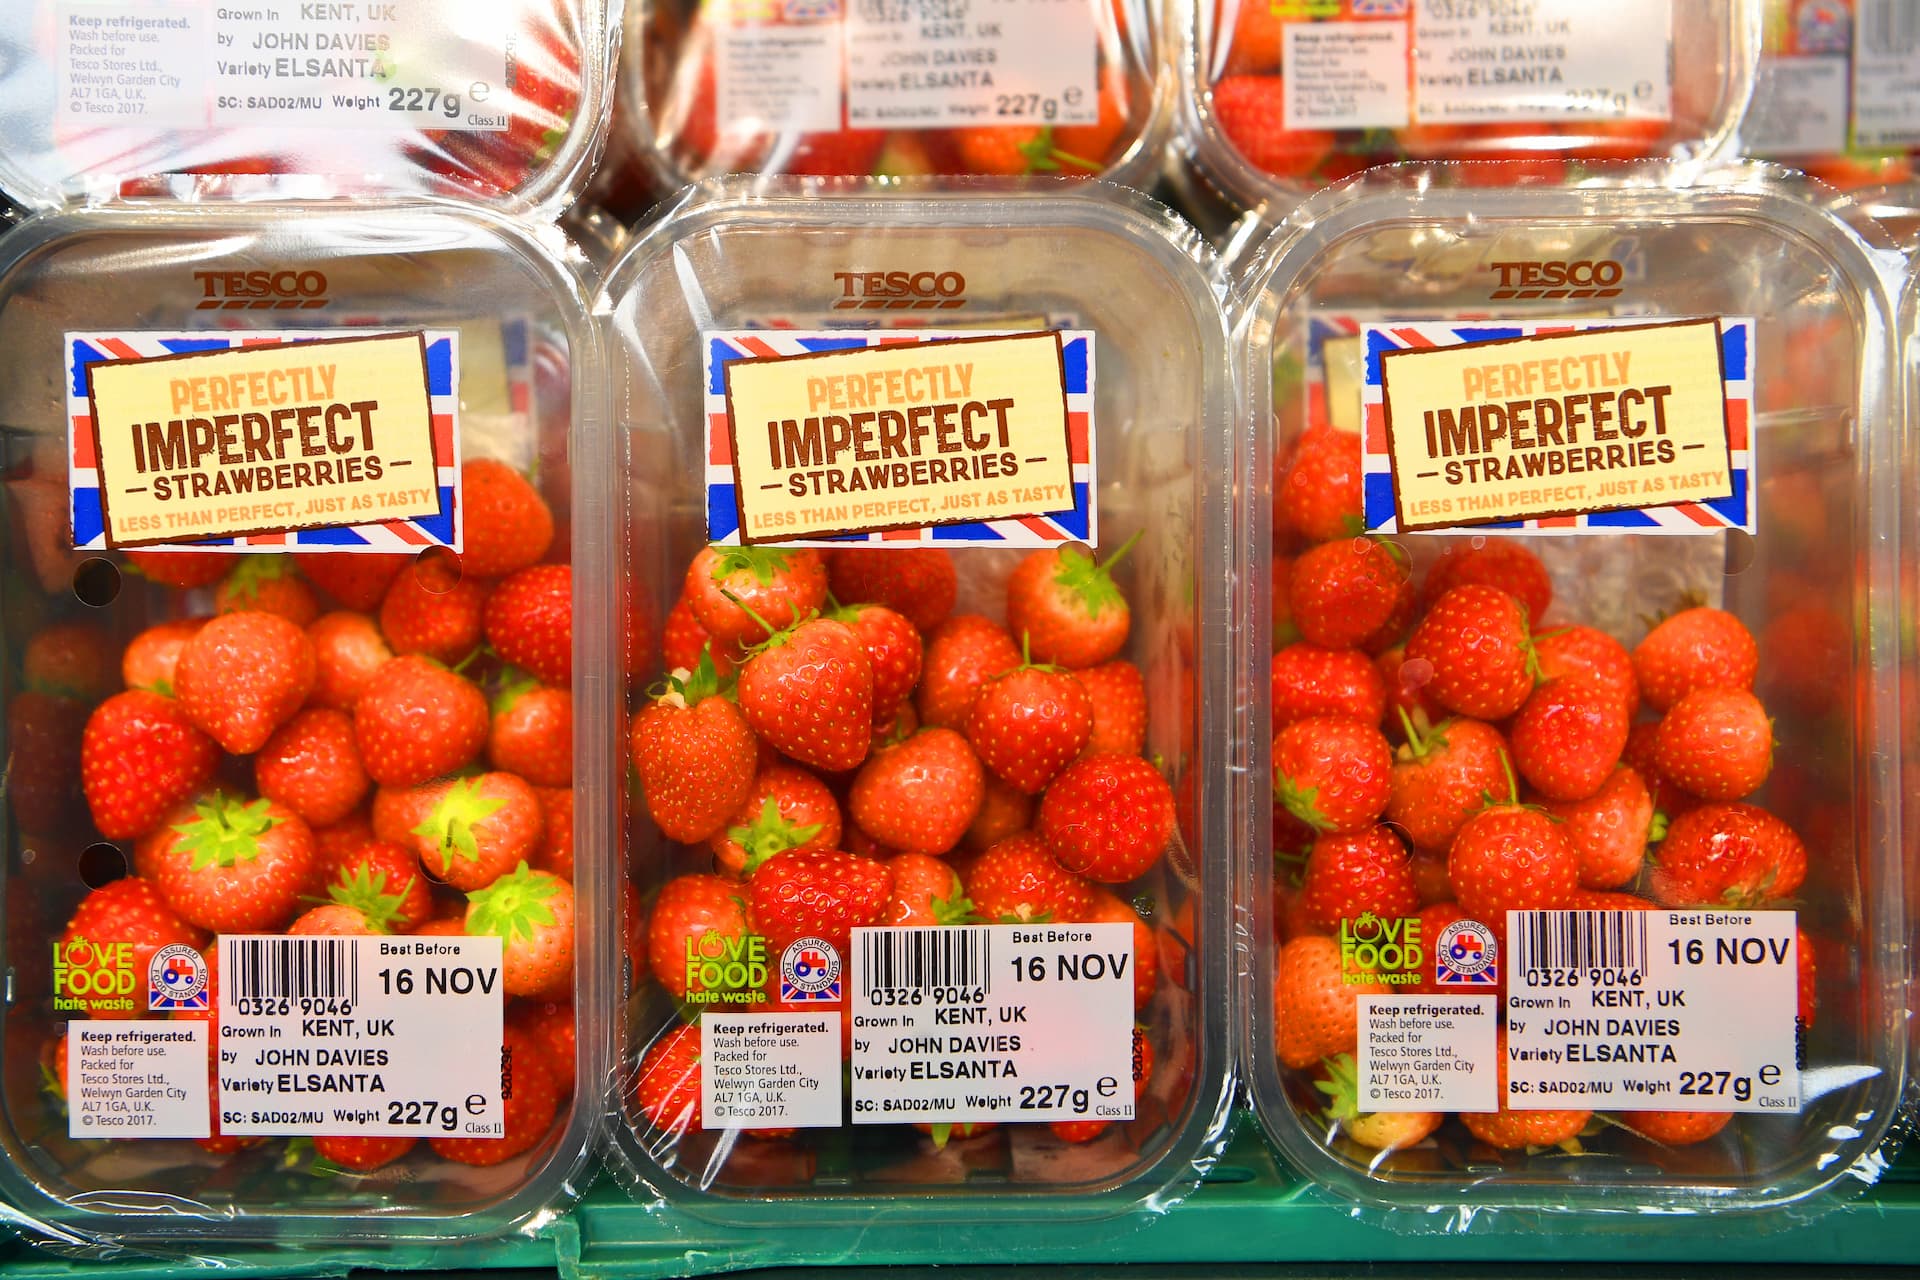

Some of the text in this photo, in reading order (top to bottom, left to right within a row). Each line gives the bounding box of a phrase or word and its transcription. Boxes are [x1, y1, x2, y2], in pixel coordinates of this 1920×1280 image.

[217, 3, 396, 22] Grown In KENT, UK
[217, 32, 390, 51] by JOHN DAVIES
[217, 58, 387, 78] Variety ELSANTA
[1467, 68, 1563, 85] ELSANTA
[899, 73, 995, 89] ELSANTA
[218, 87, 462, 118] SC: SAD02/MU Weight 227g
[996, 95, 1057, 120] 227g
[195, 270, 327, 297] TESCO
[1490, 260, 1622, 287] TESCO
[835, 271, 965, 297] TESCO
[1463, 351, 1630, 400] PERFECTLY
[170, 365, 336, 414] PERFECTLY
[807, 364, 974, 412] PERFECTLY
[1424, 386, 1671, 458] IMPERFECT
[132, 401, 378, 473] IMPERFECT
[768, 399, 1014, 470] IMPERFECT
[1446, 440, 1675, 484] STRAWBERRIES
[154, 456, 382, 500] STRAWBERRIES
[789, 452, 1018, 497] STRAWBERRIES
[1410, 472, 1723, 517] LESS THAN PERFECT, JUST AS TASTY
[119, 489, 430, 532] LESS THAN PERFECT, JUST AS TASTY
[754, 486, 1065, 529] LESS THAN PERFECT, JUST AS TASTY
[1341, 912, 1421, 944] LOVE
[1670, 914, 1751, 925] Best Before
[685, 929, 766, 962] LOVE
[1013, 931, 1091, 943] Best Before
[53, 936, 134, 968] LOVE
[381, 943, 460, 955] Best Before
[1342, 944, 1423, 970] FOOD
[1669, 938, 1789, 964] 16 NOV
[686, 962, 768, 988] FOOD
[1012, 954, 1128, 982] 16 NOV
[53, 969, 136, 995] FOOD
[379, 968, 497, 994] 16 NOV
[1343, 972, 1421, 985] hate waste
[1527, 970, 1642, 987] 0326 9046
[54, 997, 134, 1010] hate waste
[686, 990, 766, 1003] hate waste
[871, 987, 985, 1005] 0326 9046
[1510, 991, 1685, 1009] Grown In KENT, UK
[238, 999, 352, 1015] 0326 9046
[855, 1006, 1026, 1027] Grown In KENT, UK
[82, 1031, 196, 1044] Keep refrigerated.
[222, 1020, 394, 1039] Grown In KENT, UK
[714, 1022, 828, 1036] Keep refrigerated.
[1510, 1019, 1679, 1036] by JOHN DAVIES
[81, 1045, 166, 1056] Wash before use.
[855, 1036, 1020, 1053] by JOHN DAVIES
[1510, 1044, 1676, 1064] Variety ELSANTA
[81, 1059, 134, 1070] Packed for
[222, 1050, 388, 1066] by JOHN DAVIES
[81, 1074, 169, 1085] Tesco Stores Ltd.,
[855, 1060, 1017, 1082] Variety ELSANTA
[81, 1088, 186, 1100] Welwyn Garden City
[222, 1074, 385, 1094] Variety ELSANTA
[1511, 1072, 1751, 1101] SC: SAD02/MU Weight 227g
[82, 1101, 154, 1112] AL7 1GA, U.K.
[855, 1085, 1088, 1113] SC: SAD02/MU Weight 227g
[1759, 1097, 1785, 1107] Class
[96, 1115, 124, 1125] Tesco
[127, 1115, 156, 1125] 2017.
[224, 1102, 457, 1131] SC: SAD02/MU Weight 227g
[1096, 1105, 1120, 1116] Class
[465, 1123, 490, 1133] Class
